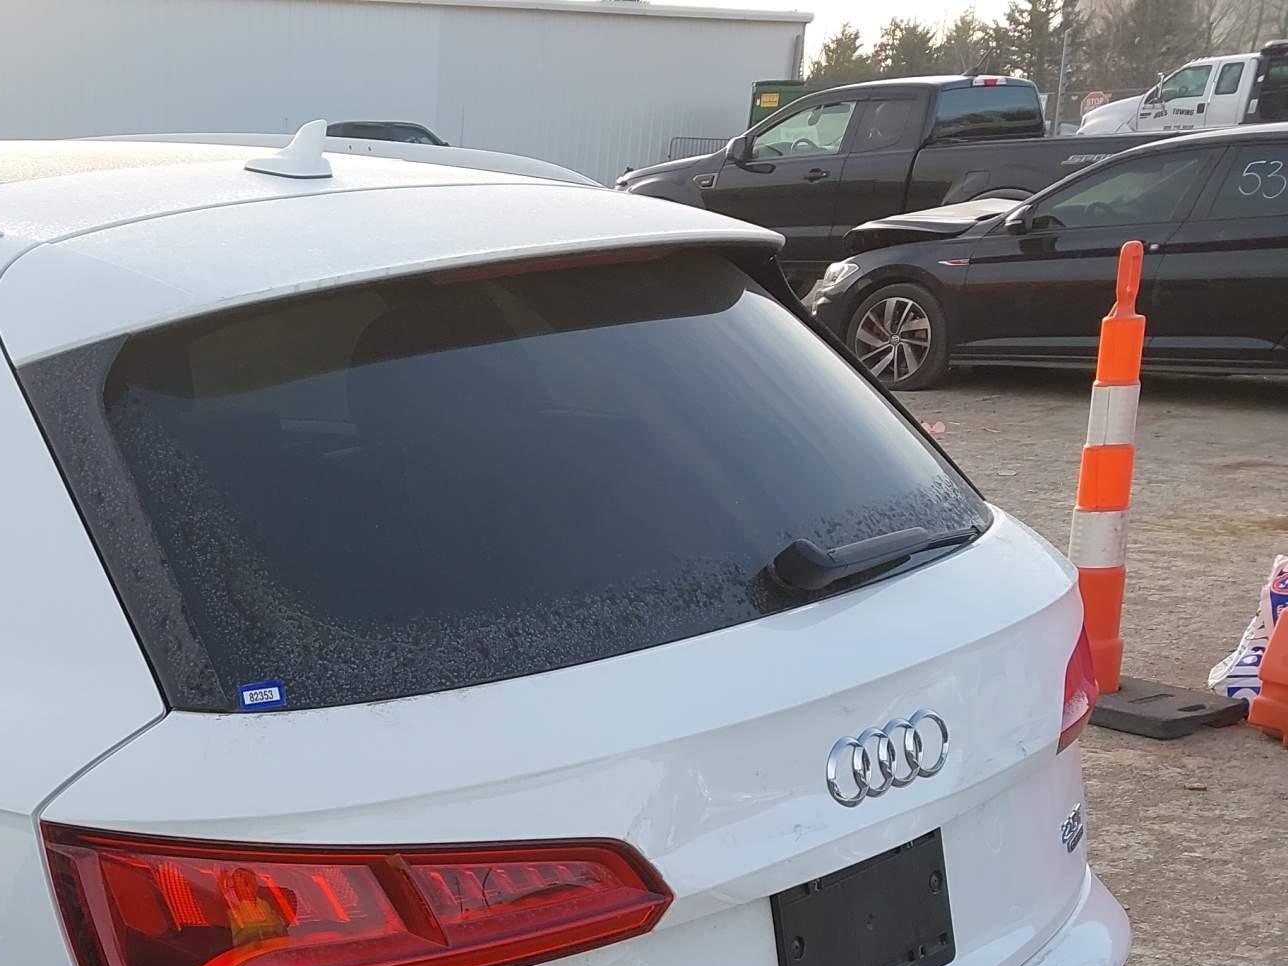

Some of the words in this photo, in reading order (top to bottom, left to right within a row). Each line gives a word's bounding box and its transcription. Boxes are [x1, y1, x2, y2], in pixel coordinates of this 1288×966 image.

[1086, 96, 1104, 106] STOP
[1172, 108, 1195, 116] TOWING
[1238, 160, 1287, 199] 53
[248, 690, 274, 703] 82353
